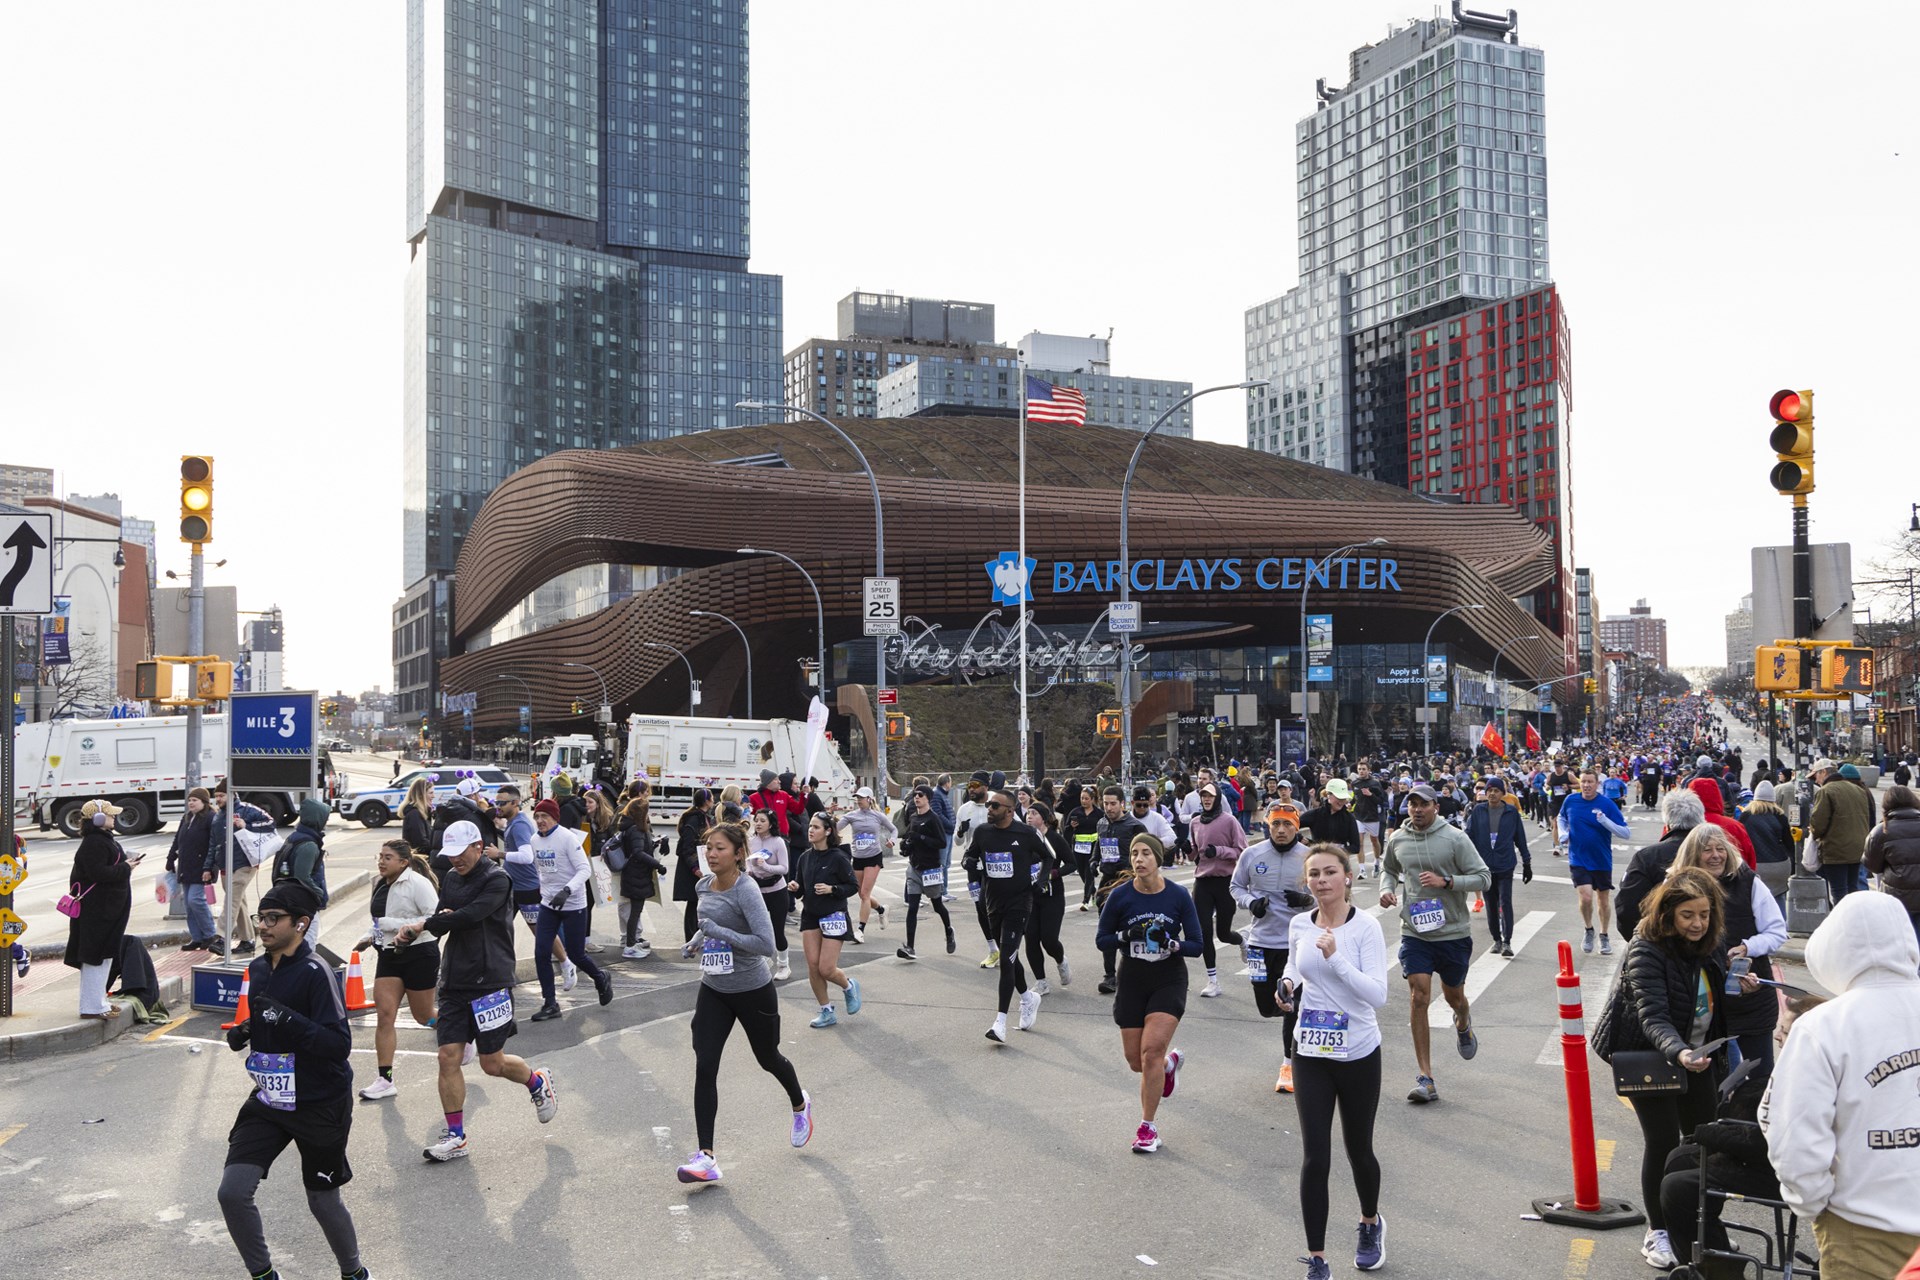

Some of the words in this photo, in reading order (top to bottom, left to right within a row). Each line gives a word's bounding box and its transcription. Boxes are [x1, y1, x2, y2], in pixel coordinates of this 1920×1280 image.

[1052, 558, 1242, 593] BARCLAYS
[1255, 557, 1402, 591] CENTER
[869, 602, 894, 616] 25
[246, 717, 276, 728] MILE
[278, 707, 296, 738] 3
